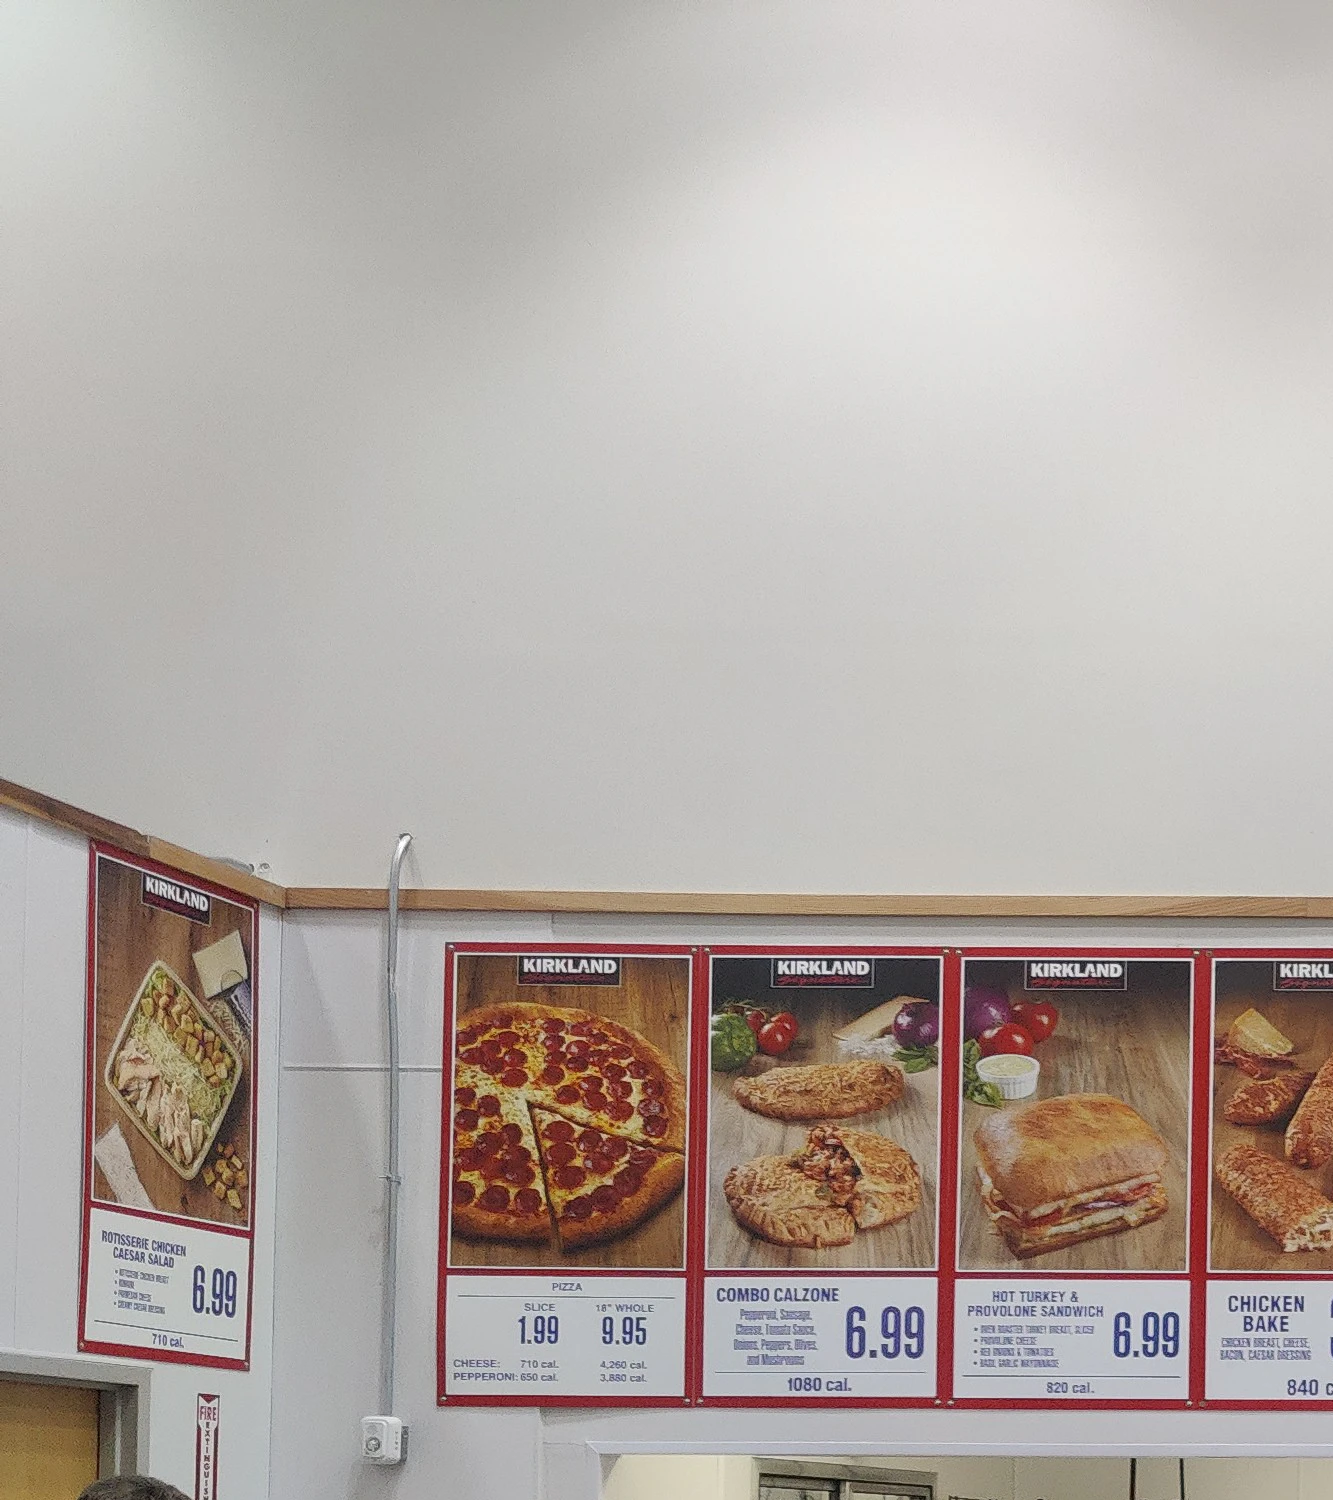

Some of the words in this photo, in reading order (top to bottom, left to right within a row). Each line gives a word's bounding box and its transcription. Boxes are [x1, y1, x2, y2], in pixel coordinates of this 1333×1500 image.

[146, 876, 210, 914] KIRKLAND
[523, 958, 617, 975] KIRKLAND
[777, 960, 870, 976] KIRKLAND
[1031, 962, 1123, 979] KIRKLAND
[102, 1230, 149, 1251] ROTISSERIE
[152, 1240, 187, 1257] CHICKEN
[113, 1247, 146, 1264] CAESAR
[148, 1253, 175, 1269] SALAD
[193, 1265, 237, 1319] 6.99
[552, 1283, 583, 1292] PIZZA
[716, 1288, 770, 1302] COMBO
[774, 1288, 840, 1302] CALZONE
[992, 1291, 1015, 1303] HOT
[1020, 1291, 1066, 1303] TURKEY
[1071, 1291, 1079, 1303] &
[1228, 1295, 1305, 1313] CHICKEN
[524, 1303, 556, 1312] SLICE
[616, 1304, 655, 1313] WHOLE
[968, 1306, 1037, 1317] PROVOLONE
[1041, 1306, 1104, 1317] SANDWICH
[518, 1315, 559, 1345] 1.99
[602, 1316, 647, 1345] 9.95
[1243, 1316, 1289, 1333] BAKE
[152, 1333, 168, 1346] 710
[846, 1306, 925, 1359] 6.99
[1113, 1311, 1180, 1358] 6.99
[453, 1359, 501, 1369] CHEESE:
[521, 1360, 538, 1369] 710
[453, 1373, 519, 1382] PEPPERONI:
[521, 1374, 538, 1382] 650
[788, 1377, 822, 1392] 1080
[826, 1378, 852, 1392] cal.
[1072, 1383, 1095, 1394] cal.
[1287, 1379, 1319, 1396] 840
[200, 1406, 217, 1421] FIRE
